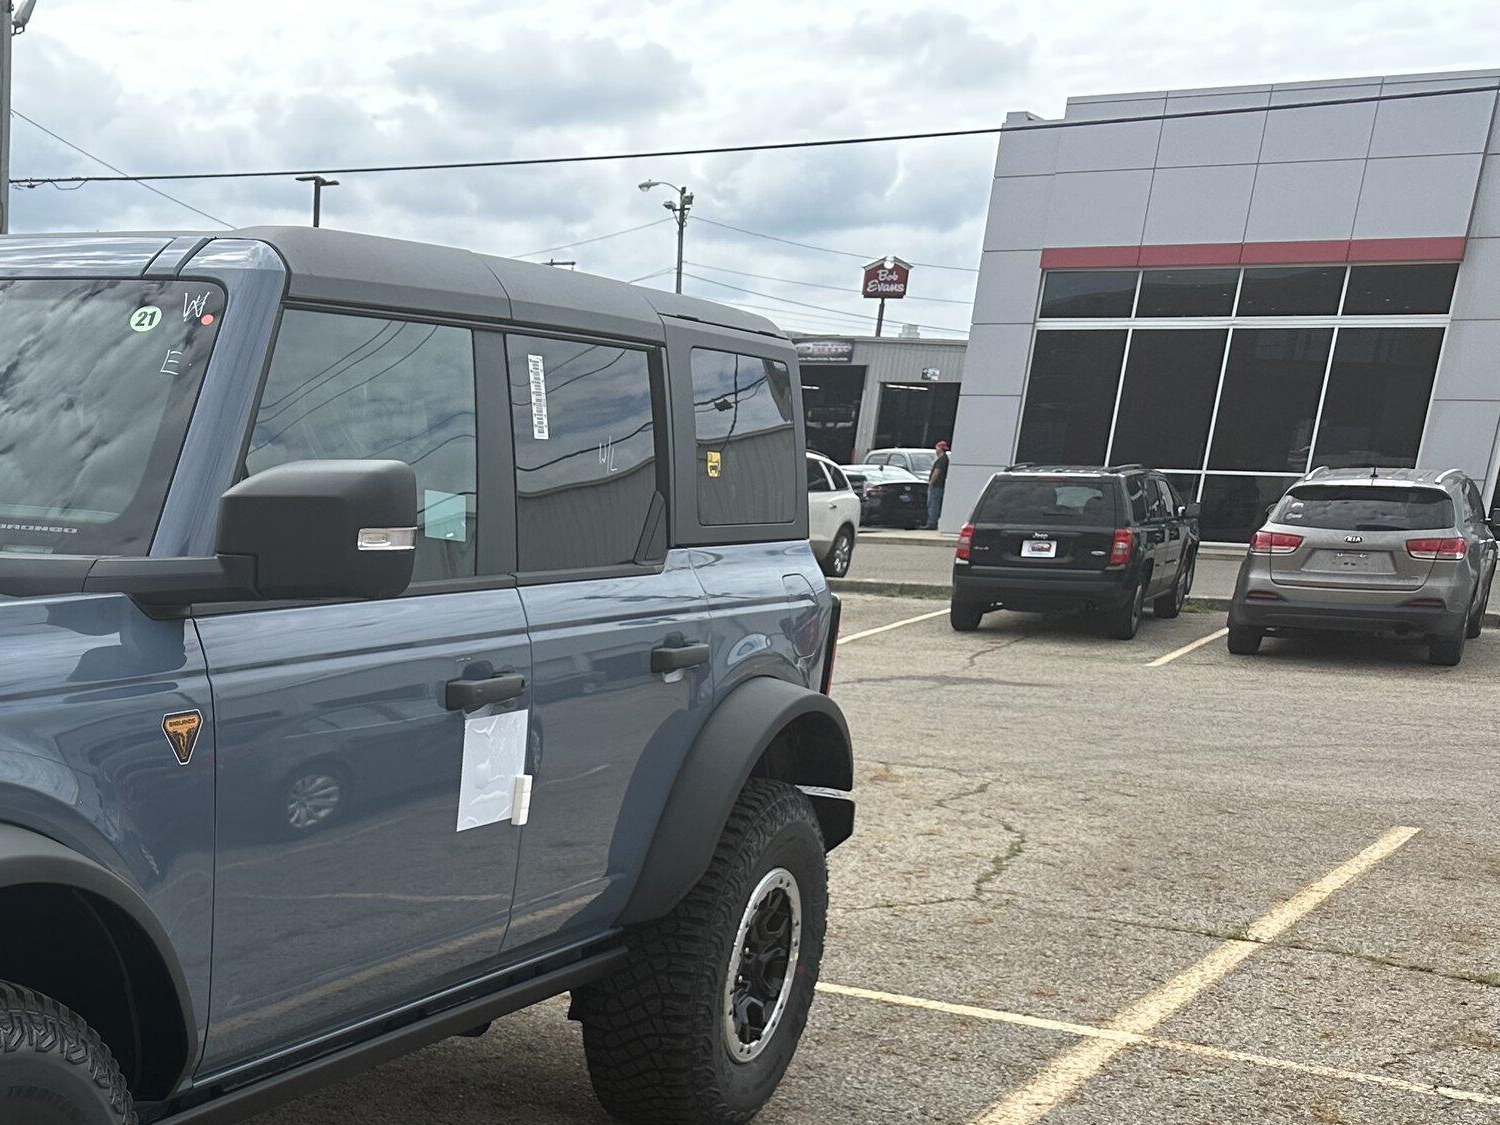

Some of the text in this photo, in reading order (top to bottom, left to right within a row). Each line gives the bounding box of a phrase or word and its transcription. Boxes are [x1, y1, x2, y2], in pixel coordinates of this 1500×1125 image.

[877, 269, 899, 281] Bob
[867, 279, 905, 292] Evans
[135, 311, 157, 327] 21
[1346, 535, 1361, 543] KIA
